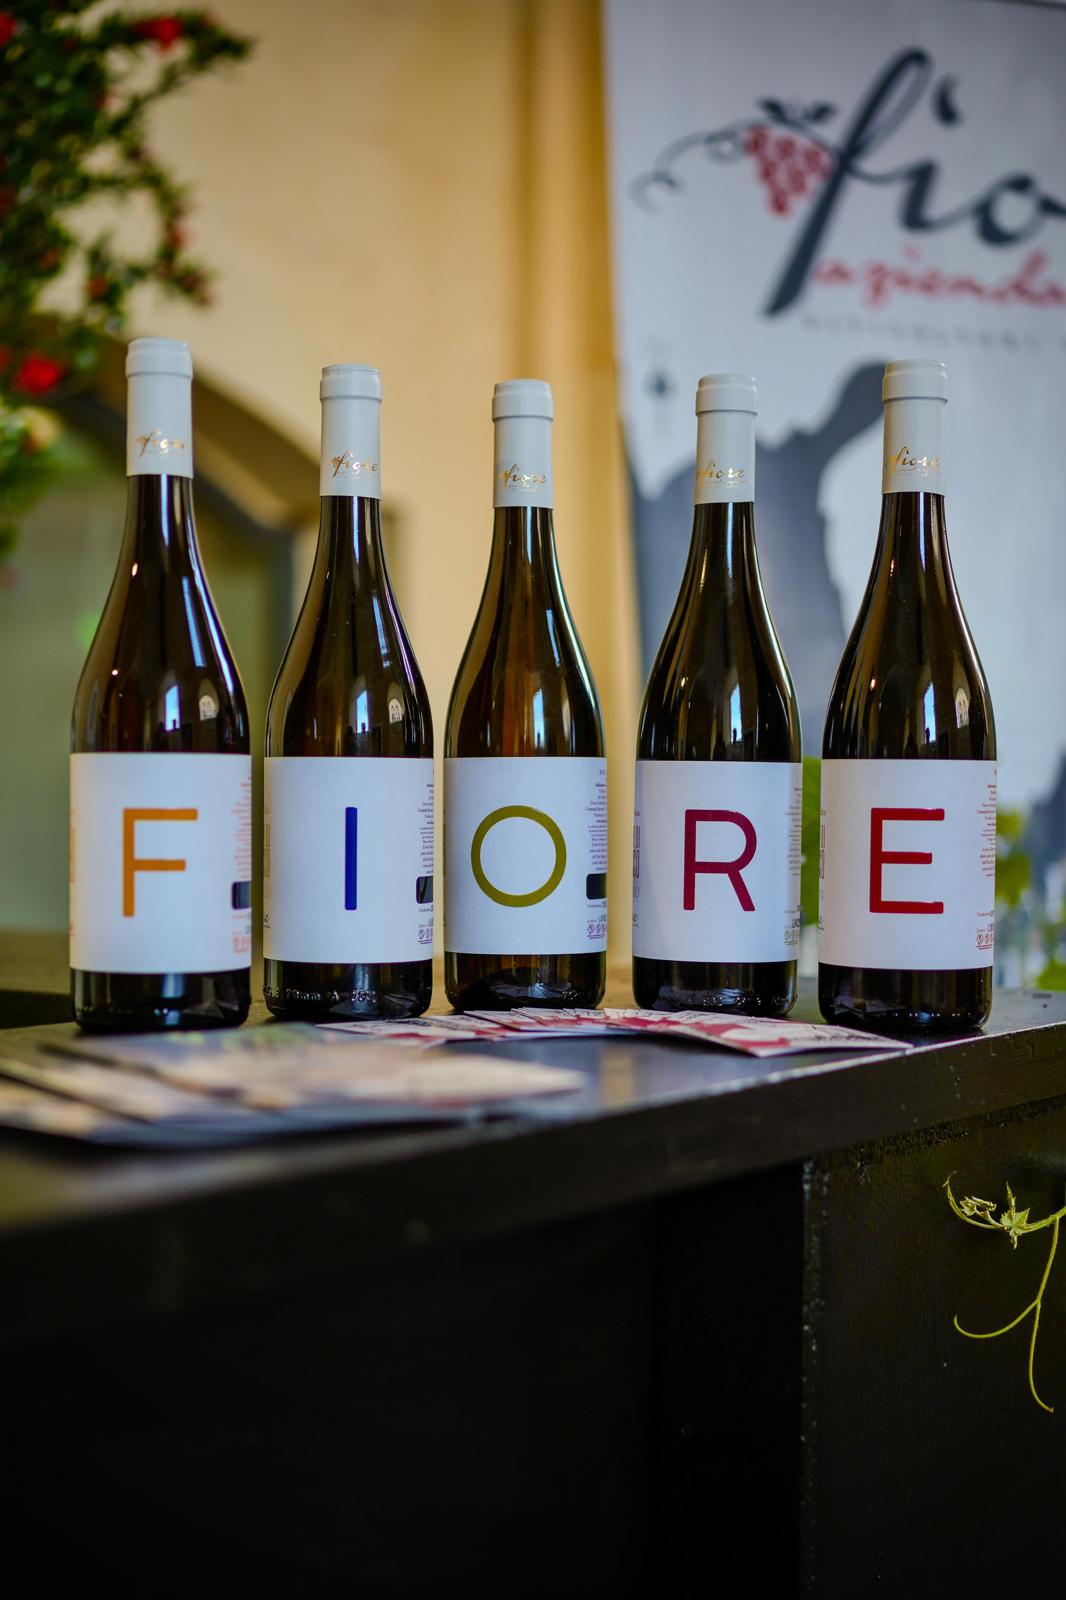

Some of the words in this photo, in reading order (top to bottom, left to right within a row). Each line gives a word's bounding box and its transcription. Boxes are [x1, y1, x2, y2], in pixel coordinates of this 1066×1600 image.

[122, 808, 198, 917] F
[344, 806, 358, 911] I
[471, 805, 567, 908] O
[683, 809, 757, 912] R
[869, 807, 945, 915] E
